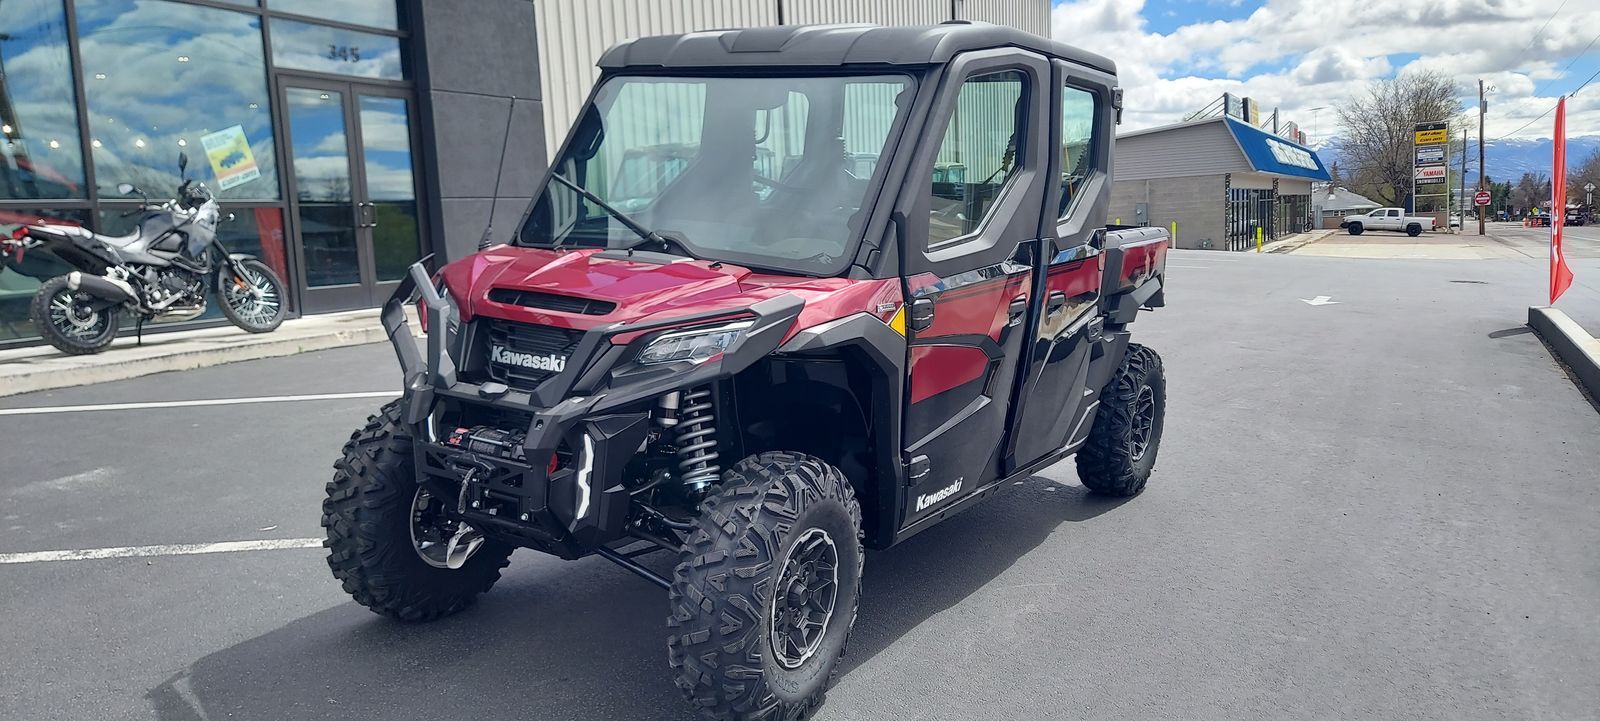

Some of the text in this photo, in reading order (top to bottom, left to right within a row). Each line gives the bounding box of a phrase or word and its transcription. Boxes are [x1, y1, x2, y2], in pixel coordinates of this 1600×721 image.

[327, 43, 360, 63] 345
[491, 345, 566, 373] Kawasaki
[915, 476, 963, 512] Kawasaki
